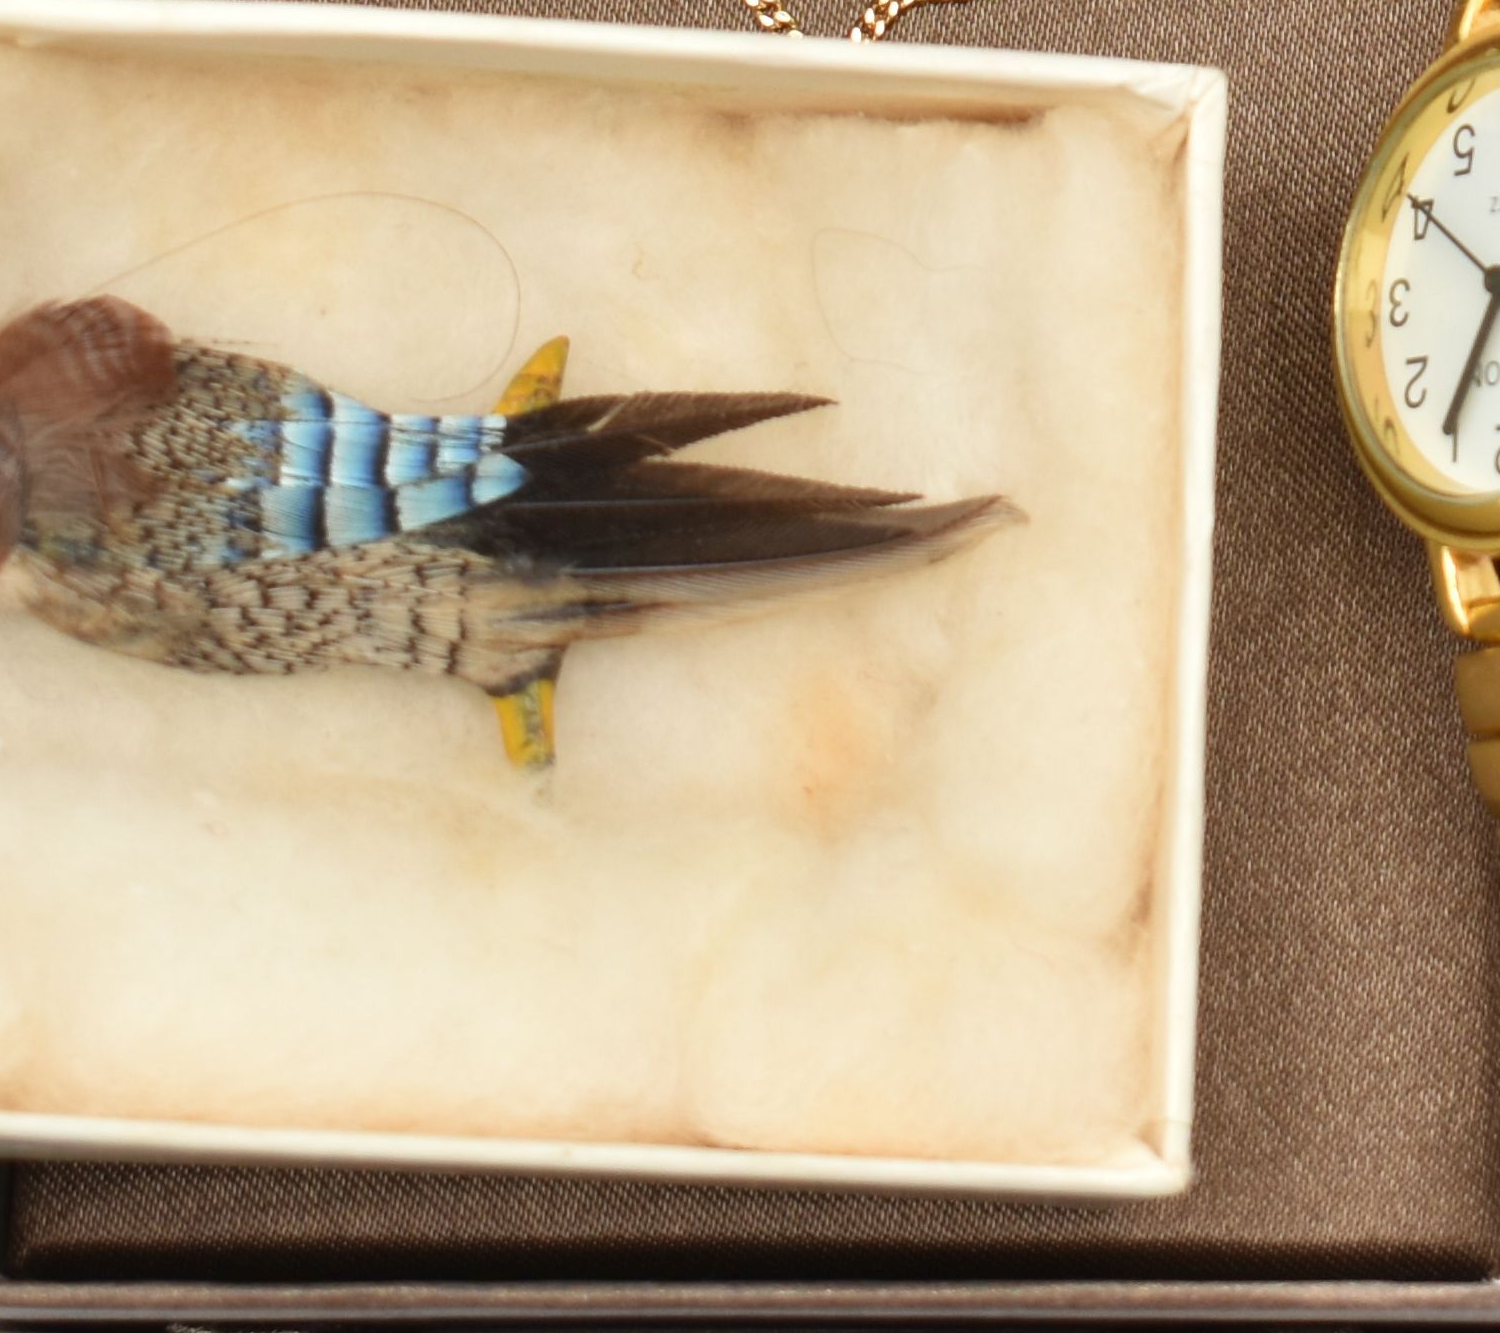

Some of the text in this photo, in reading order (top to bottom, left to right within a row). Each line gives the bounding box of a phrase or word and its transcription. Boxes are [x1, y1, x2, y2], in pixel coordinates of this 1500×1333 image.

[1453, 123, 1476, 177] 5
[1388, 278, 1411, 328] 3
[1404, 355, 1429, 409] 2
